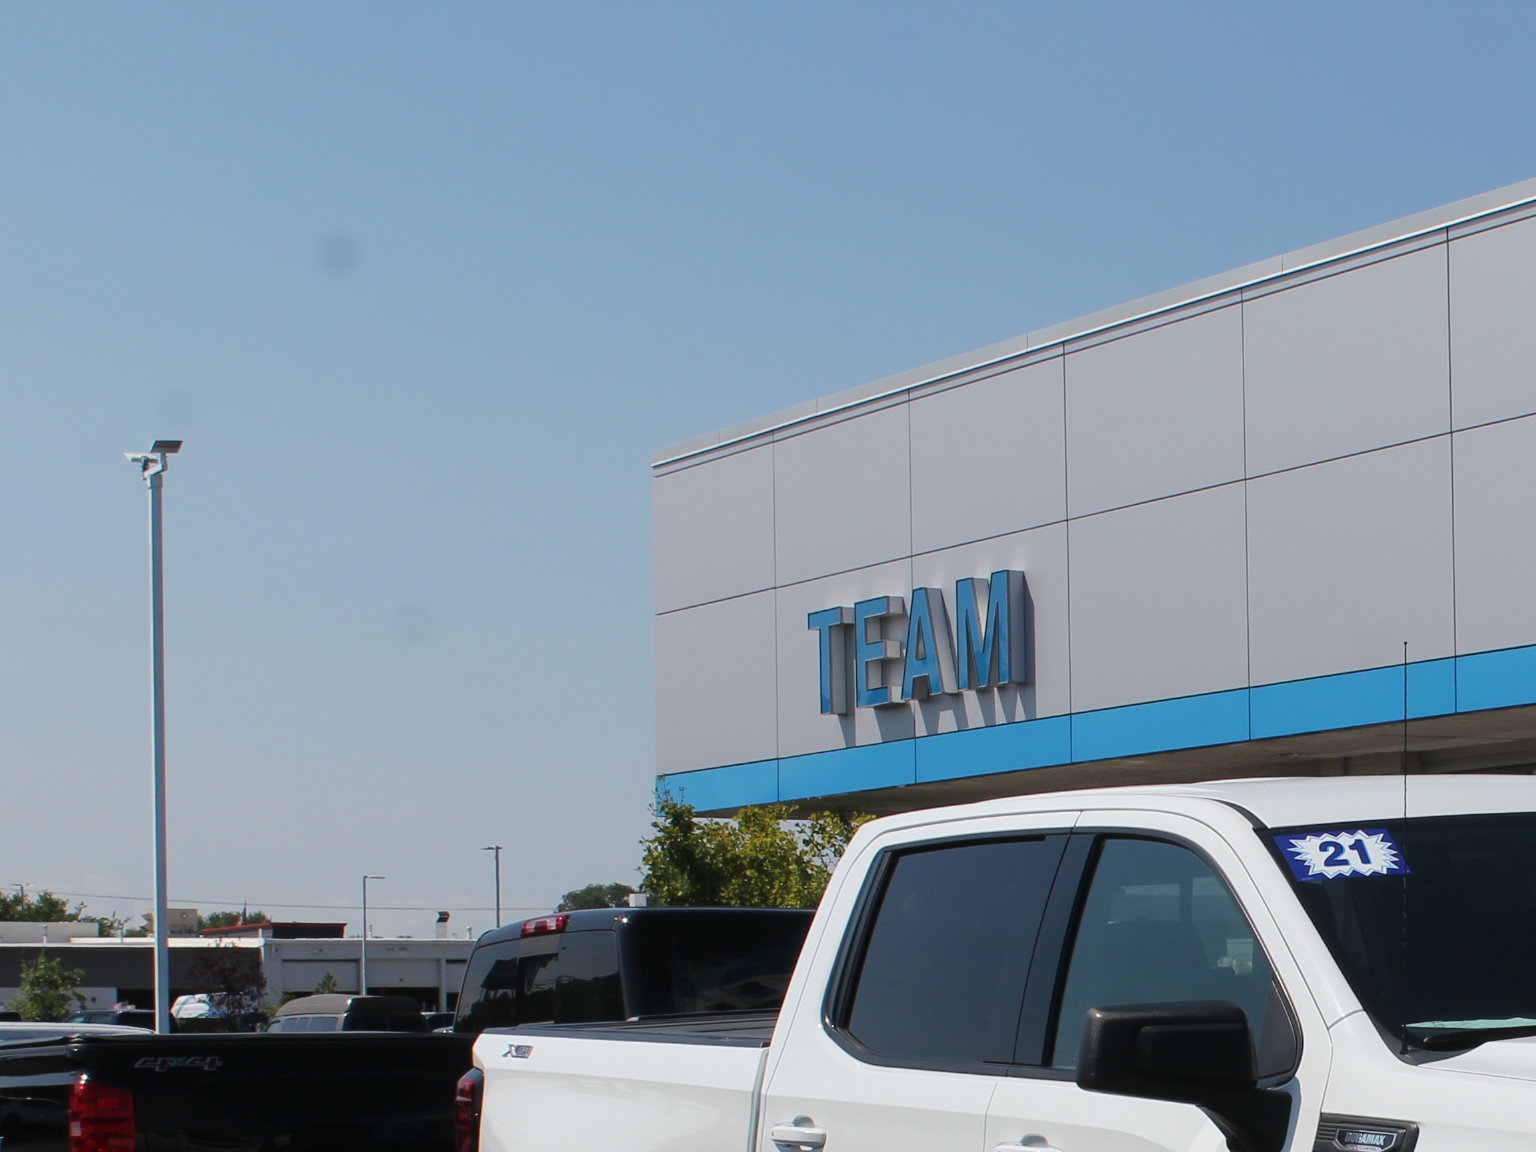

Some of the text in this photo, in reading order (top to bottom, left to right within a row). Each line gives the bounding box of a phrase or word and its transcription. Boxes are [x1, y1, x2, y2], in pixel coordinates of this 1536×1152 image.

[807, 569, 1025, 715] TEAM
[1318, 838, 1373, 867] 21
[1344, 1132, 1386, 1146] DURAMAX
